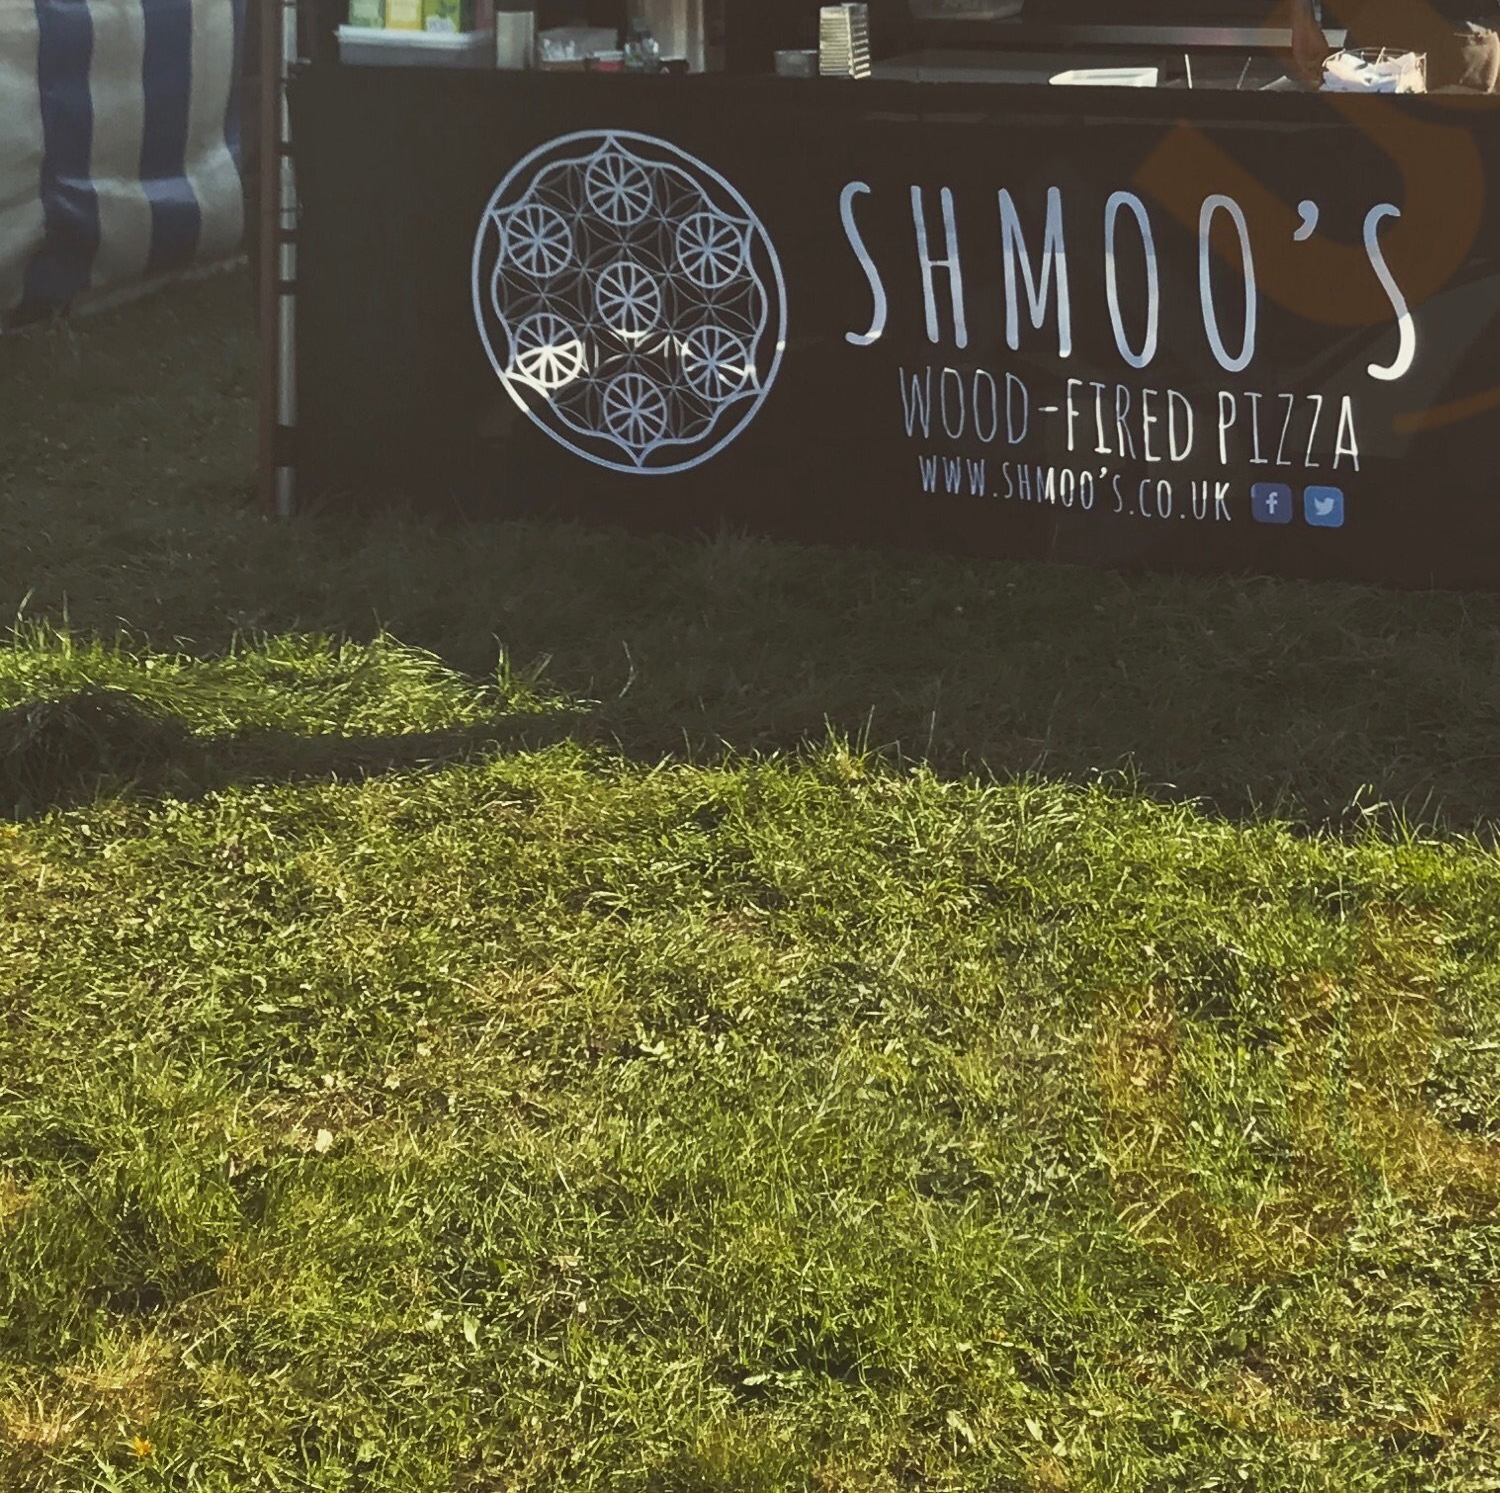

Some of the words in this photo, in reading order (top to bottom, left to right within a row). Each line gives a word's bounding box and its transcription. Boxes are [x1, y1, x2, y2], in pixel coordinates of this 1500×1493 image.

[840, 182, 1416, 380] SHMOO'S
[899, 366, 1193, 461] WOOD-FIRED
[1218, 391, 1359, 471] PIZZA
